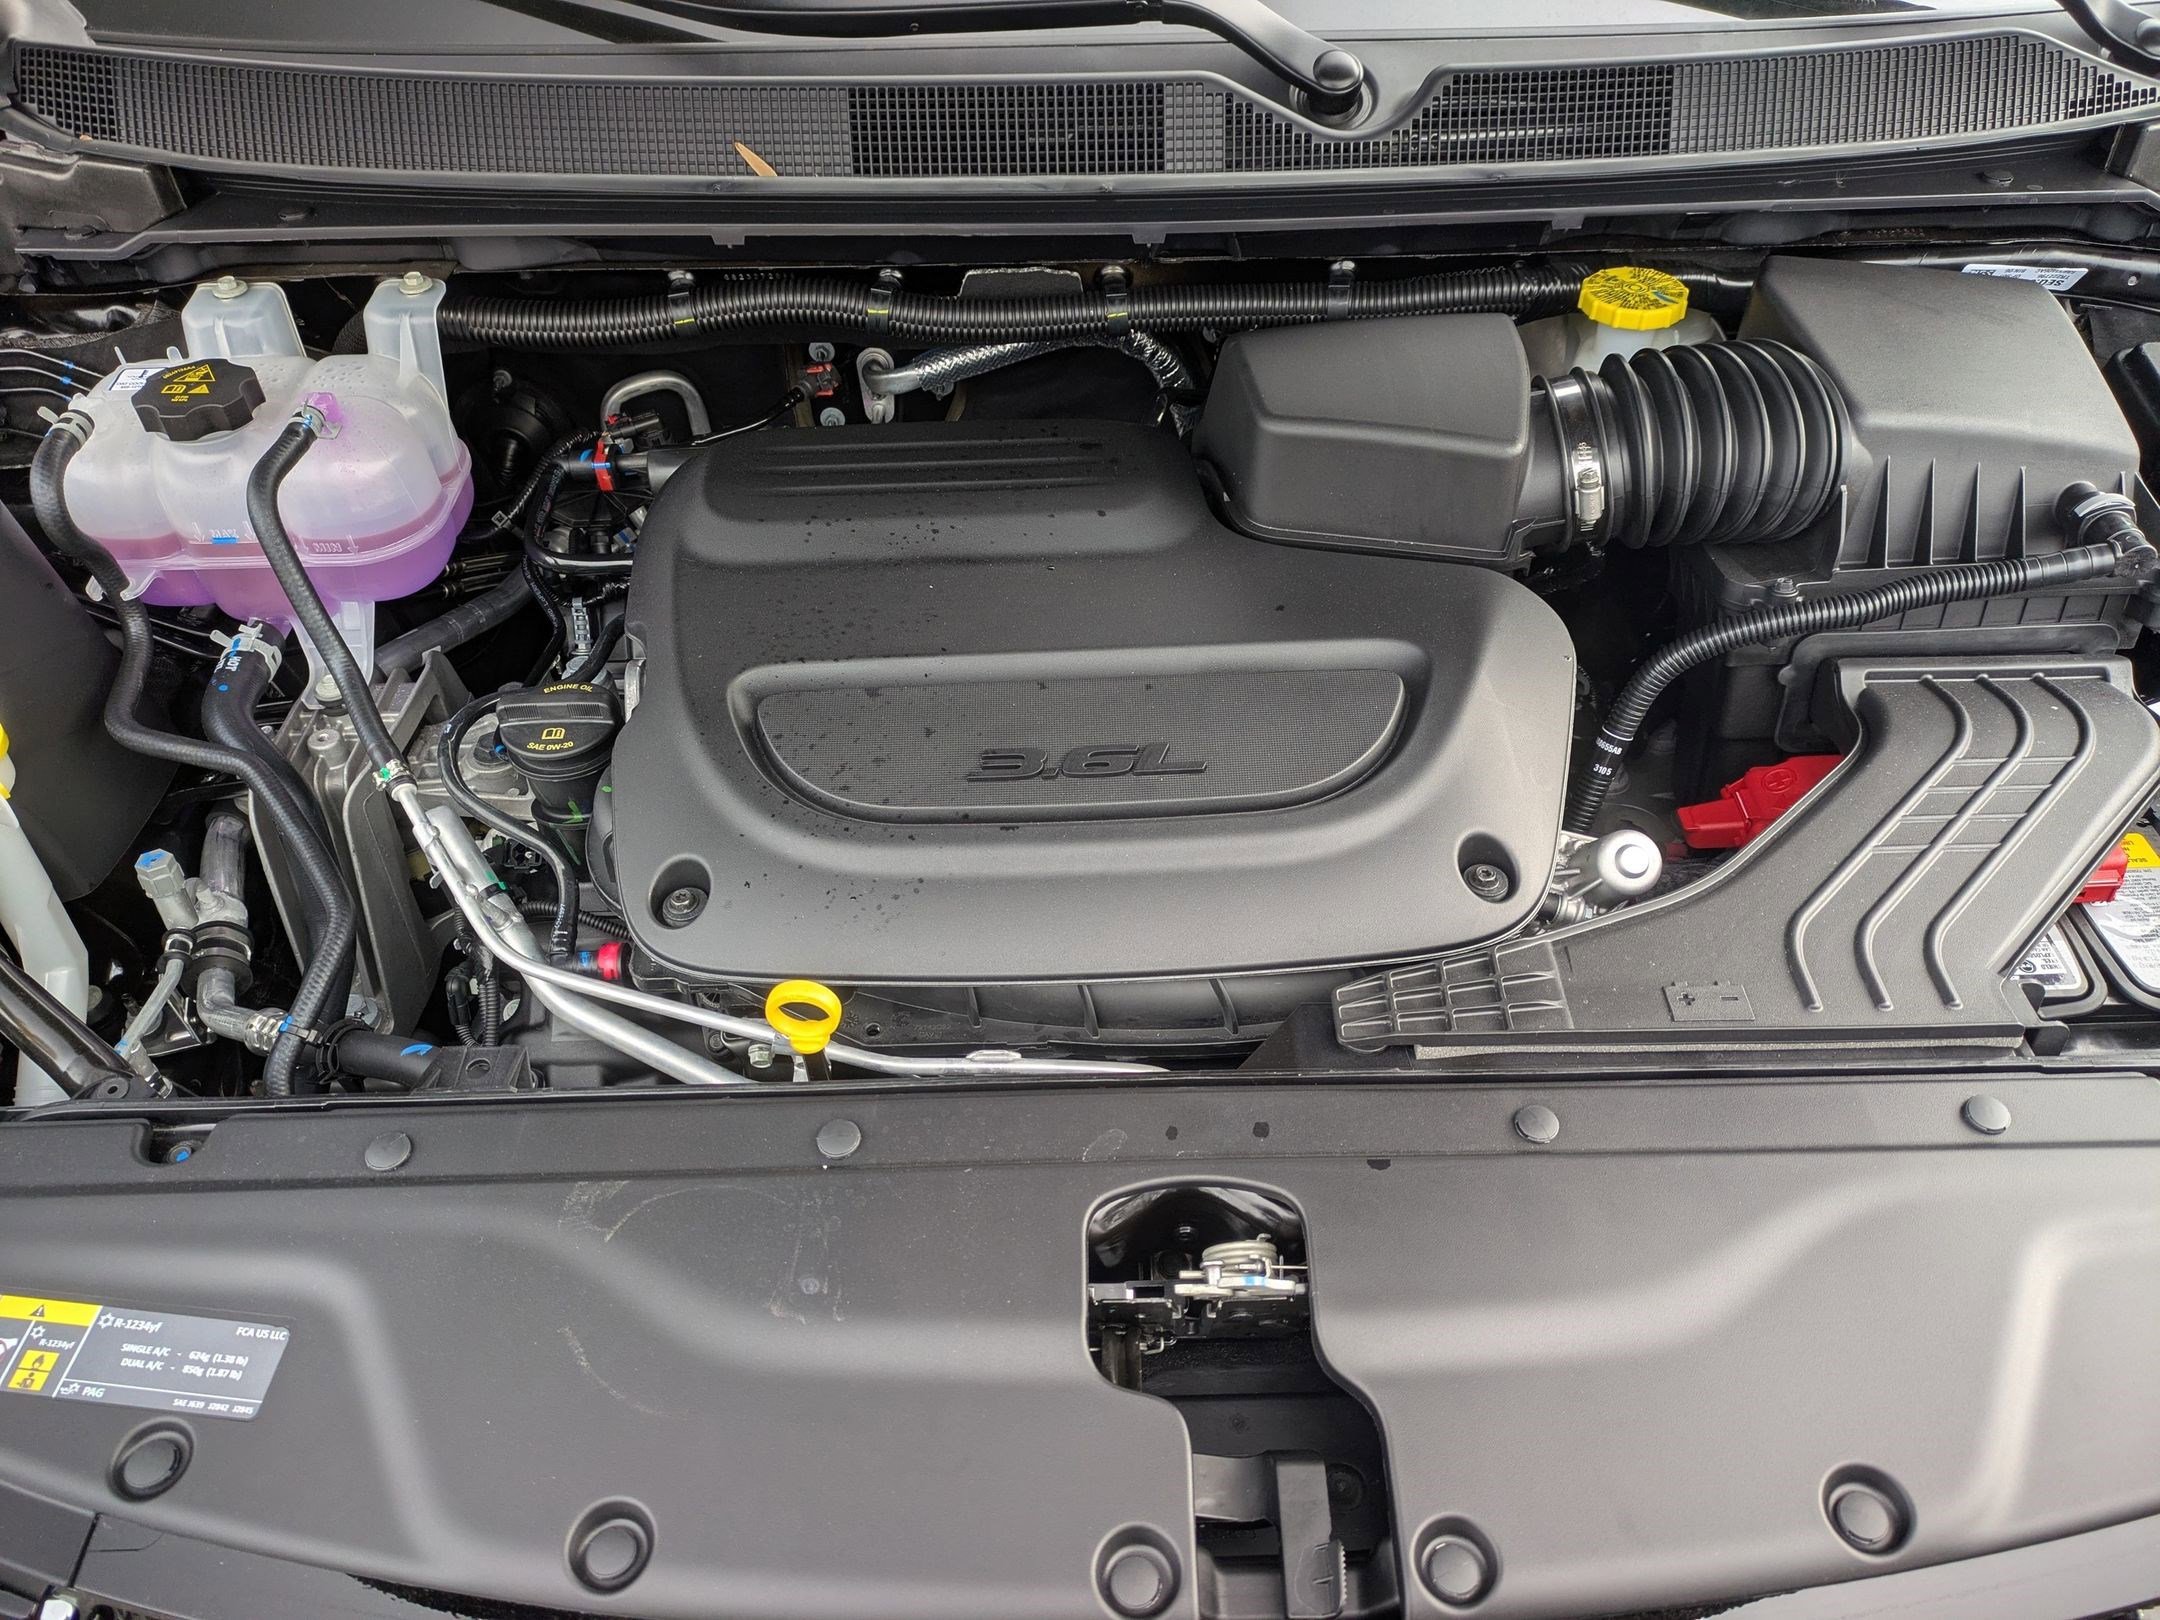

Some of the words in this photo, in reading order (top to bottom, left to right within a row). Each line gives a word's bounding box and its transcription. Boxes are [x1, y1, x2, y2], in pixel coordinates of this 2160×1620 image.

[543, 683, 579, 694] ENGINE
[580, 684, 593, 693] OIL
[526, 742, 546, 751] SAE
[546, 741, 574, 750] 0W-20
[966, 742, 1208, 783] 3.6L
[1593, 763, 1613, 776] 3105
[113, 1318, 163, 1333] R-1234yf
[236, 1326, 255, 1338] FCA
[256, 1328, 269, 1339] US
[270, 1330, 288, 1341] LLC
[38, 1339, 76, 1350] R-1234yf
[120, 1343, 152, 1354] SINGLE
[152, 1346, 171, 1357] A/C
[188, 1351, 211, 1363] 624g
[120, 1358, 146, 1368] DUAL
[146, 1360, 165, 1371] A/C
[82, 1386, 106, 1398] PAG
[172, 1398, 188, 1407] SAE
